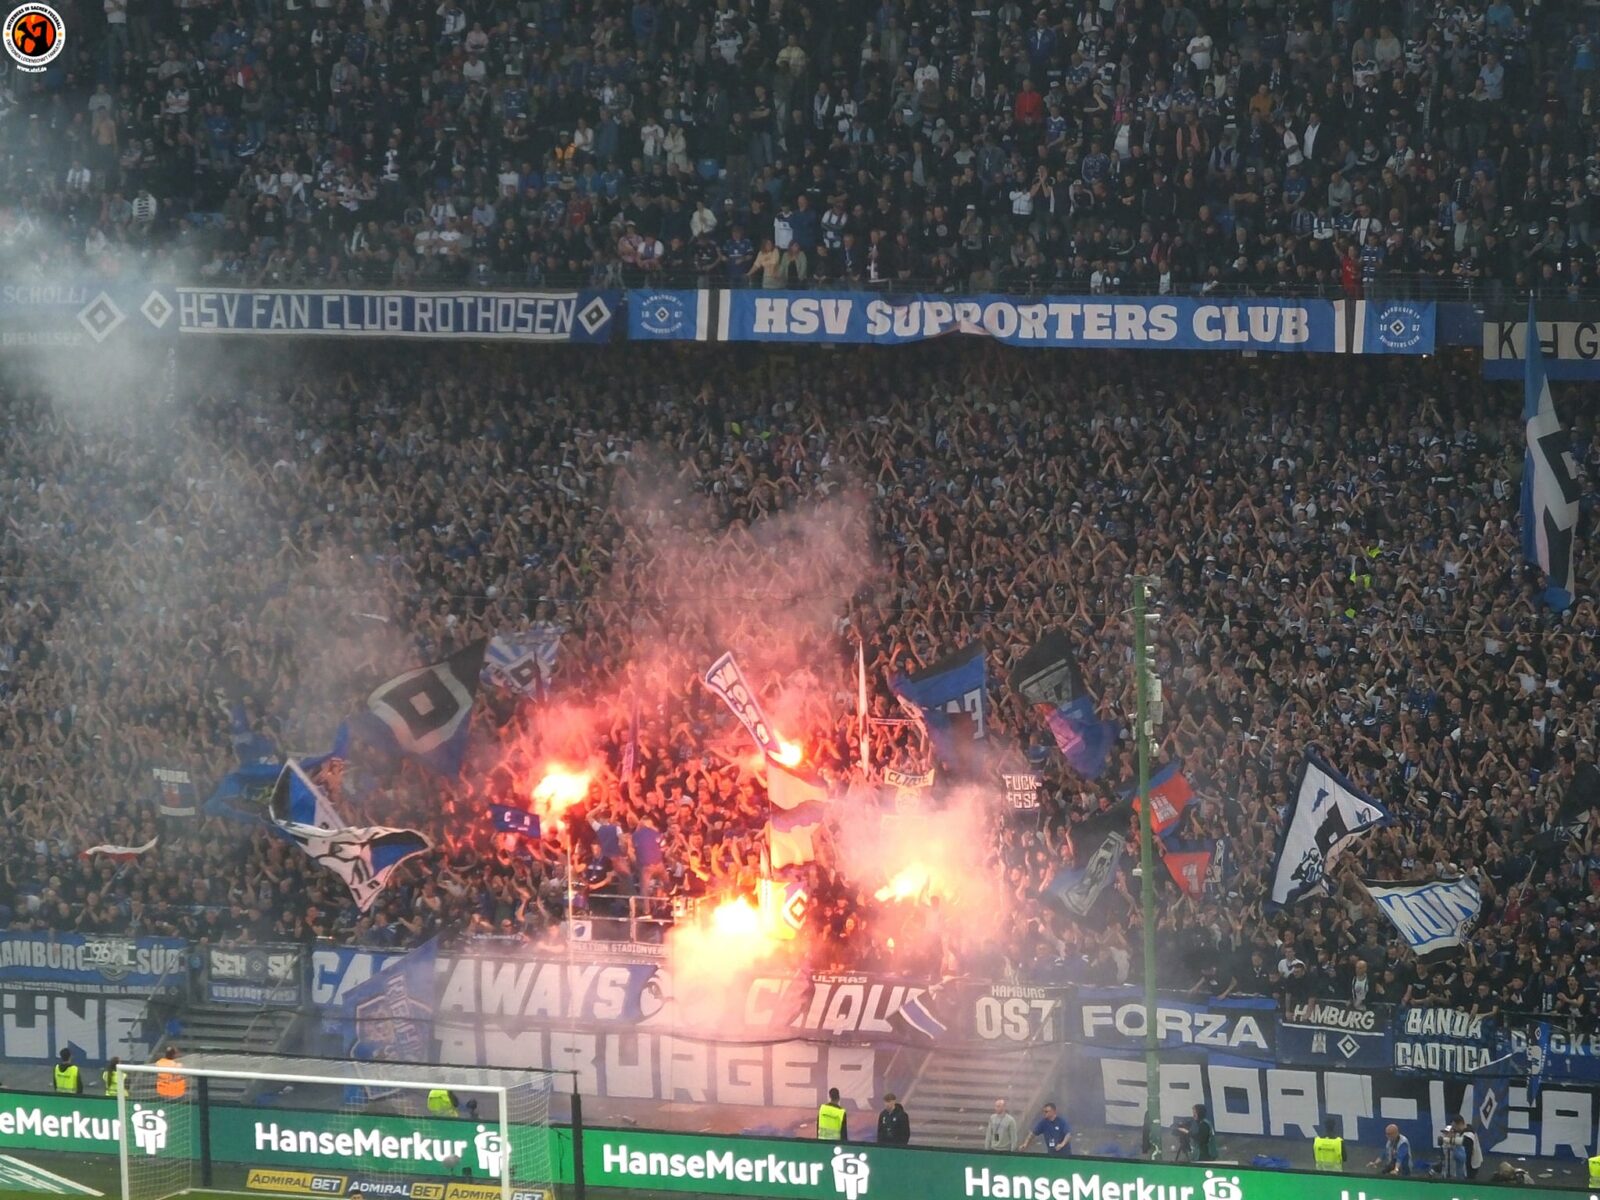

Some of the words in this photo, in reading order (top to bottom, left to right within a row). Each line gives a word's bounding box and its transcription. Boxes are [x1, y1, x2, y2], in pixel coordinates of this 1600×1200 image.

[180, 294, 238, 328] HSV
[252, 295, 310, 329] FAN
[322, 296, 401, 331] CLUB
[414, 297, 577, 334] ROTHOSEN
[753, 297, 852, 335] HSV
[866, 299, 1178, 342] SUPPORTERS
[1192, 304, 1310, 344] CLUB
[136, 944, 180, 975] SÜD
[311, 950, 630, 1021] CAAWAYS
[811, 974, 868, 985] ULTRAS
[991, 985, 1046, 999] HAMBURG
[1081, 1004, 1269, 1049] FORZA
[1405, 1007, 1482, 1039] BANDA
[435, 1024, 876, 1111] AMBURGER
[1395, 1041, 1491, 1075] CAOTICA
[254, 1121, 468, 1164] HanseMerkur
[602, 1143, 823, 1186] HanseMerkur
[964, 1166, 1194, 1200] HanseMerkur
[450, 1187, 543, 1200] ADMIRABET
